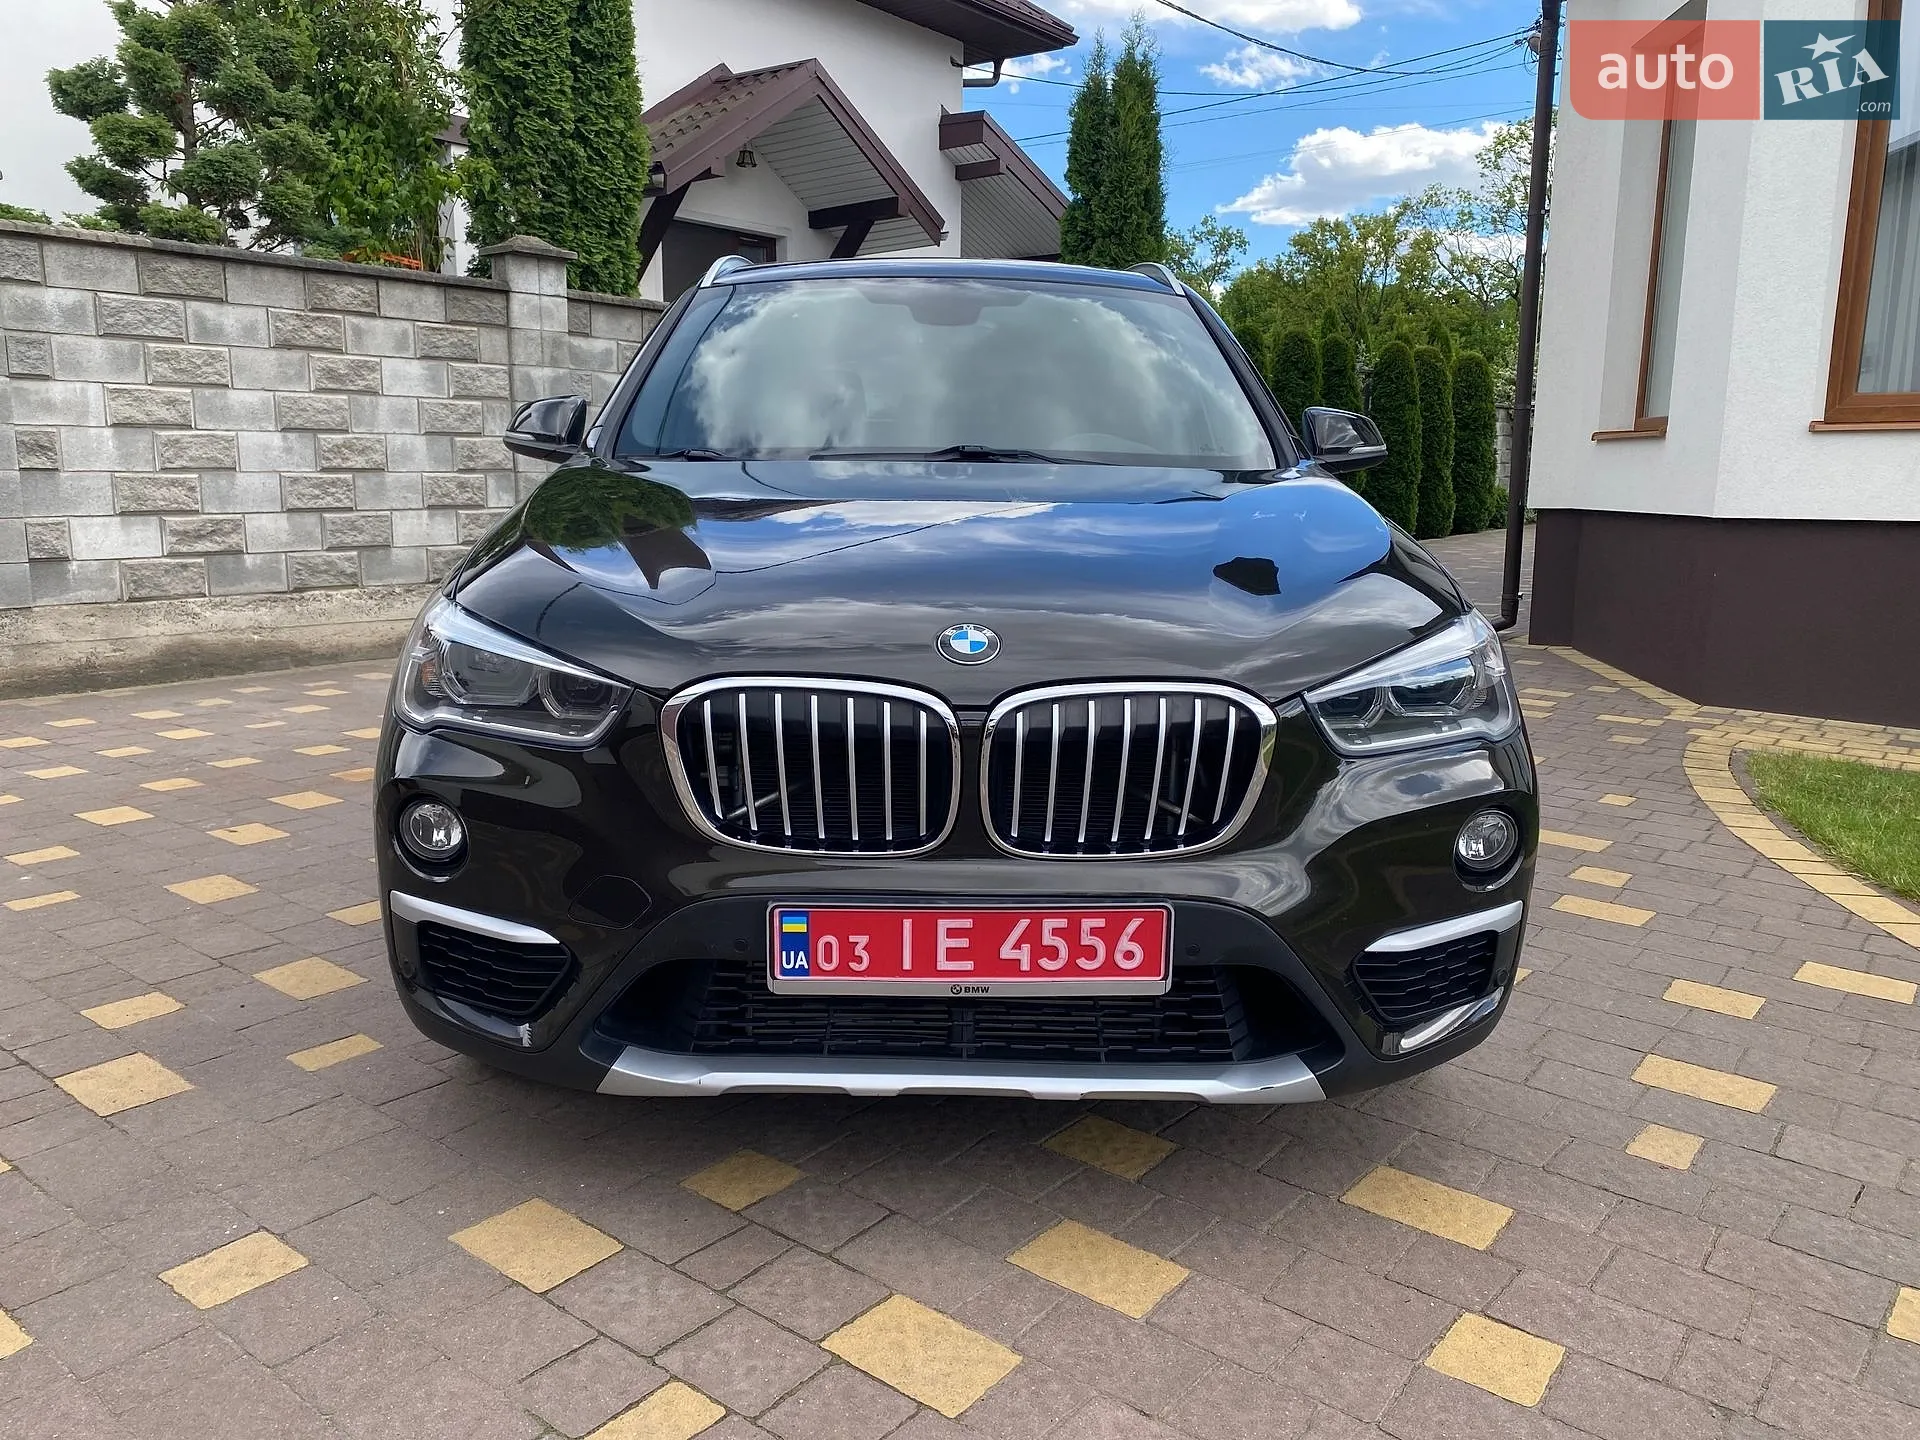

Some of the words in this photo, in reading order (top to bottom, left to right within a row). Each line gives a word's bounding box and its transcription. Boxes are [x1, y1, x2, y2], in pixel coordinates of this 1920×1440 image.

[782, 950, 808, 969] UA
[816, 934, 870, 972] 03
[902, 918, 975, 971] IE
[999, 918, 1145, 971] 4556
